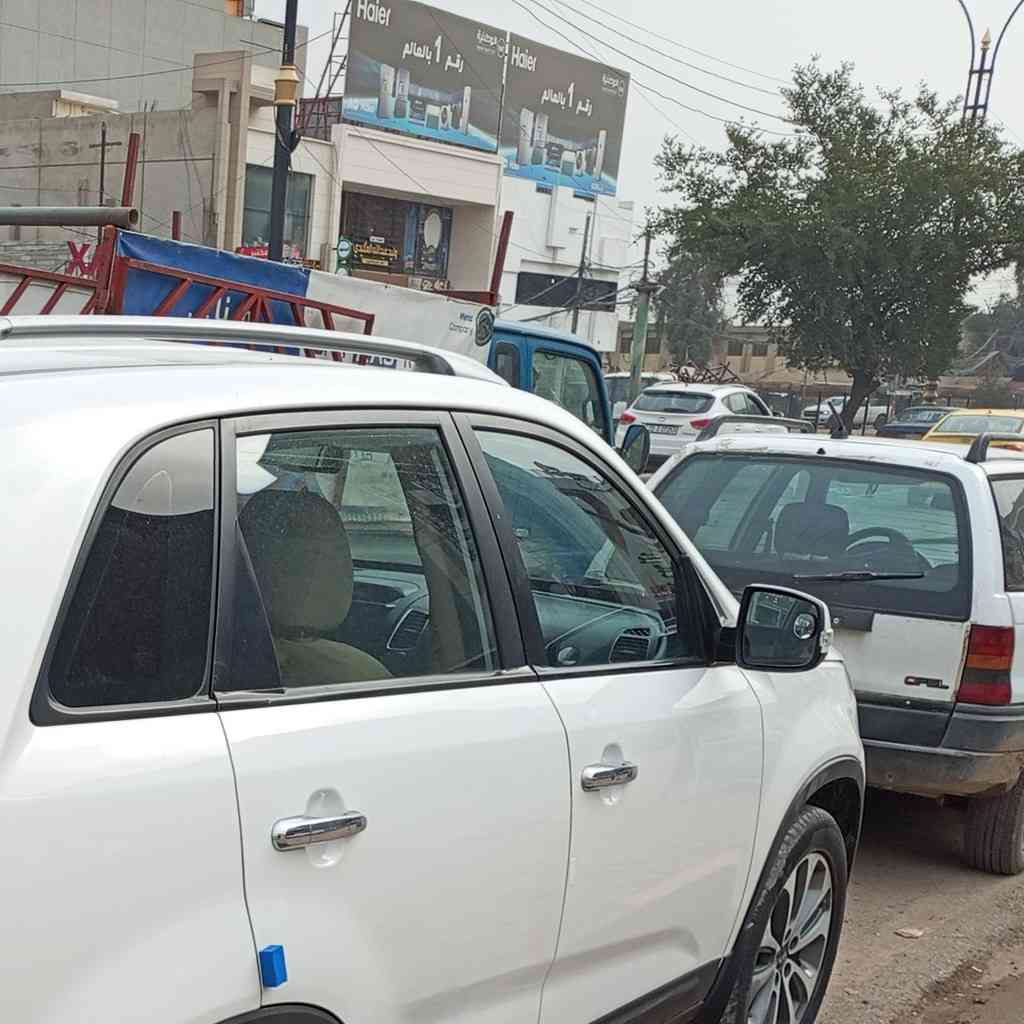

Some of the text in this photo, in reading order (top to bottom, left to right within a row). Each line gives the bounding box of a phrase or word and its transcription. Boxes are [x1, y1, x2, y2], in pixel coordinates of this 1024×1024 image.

[356, 0, 391, 26] Haier
[402, 35, 464, 72] رقم 1 بالعالم
[511, 45, 537, 72] Haier
[541, 82, 592, 116] رقم 1 بالعالم
